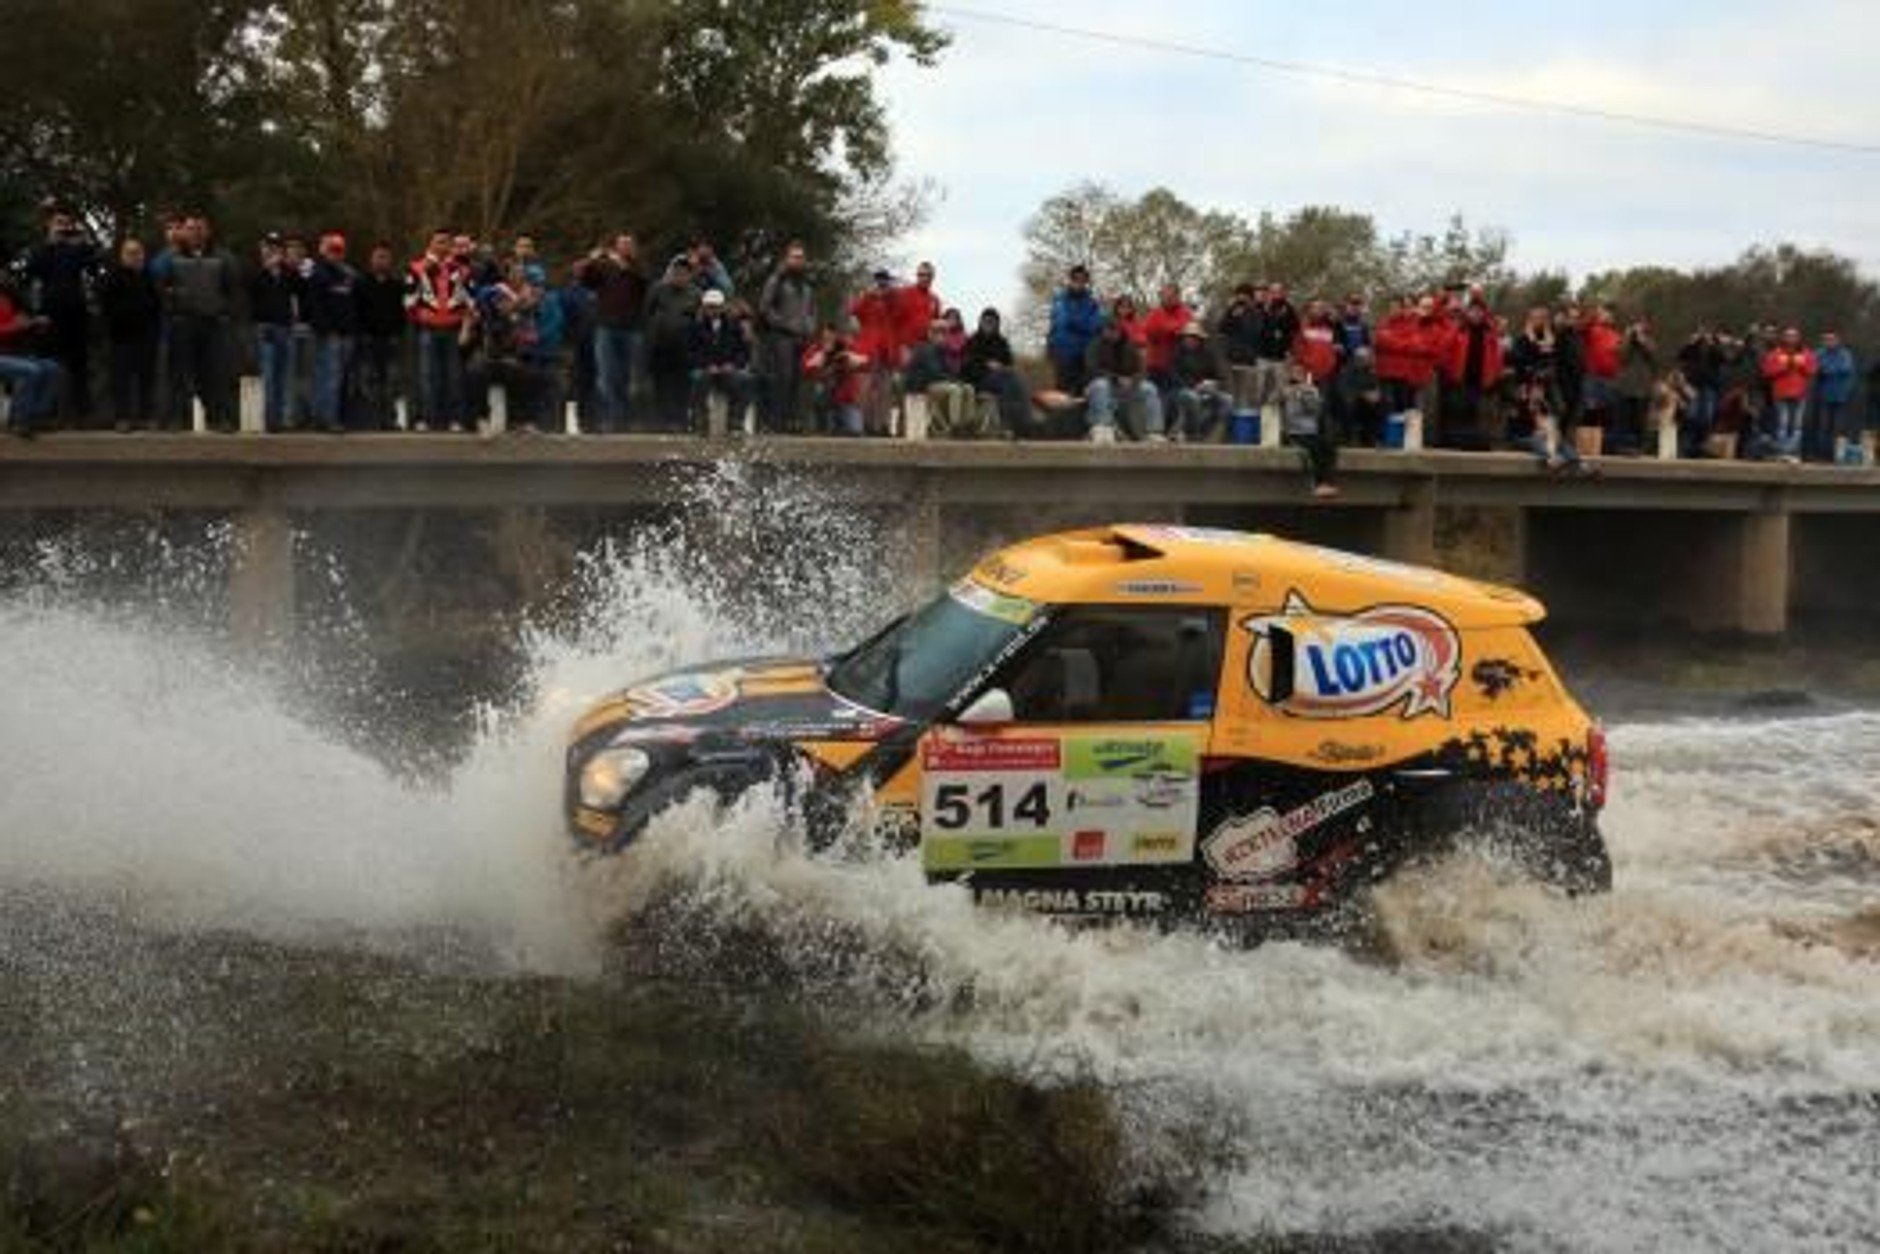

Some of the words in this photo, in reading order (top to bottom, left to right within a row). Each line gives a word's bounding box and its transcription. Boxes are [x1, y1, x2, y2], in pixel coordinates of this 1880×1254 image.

[1307, 631, 1416, 696] LOTTO
[934, 782, 1050, 828] 514
[981, 890, 1080, 913] MAGNA
[1085, 891, 1165, 912] STEYR
